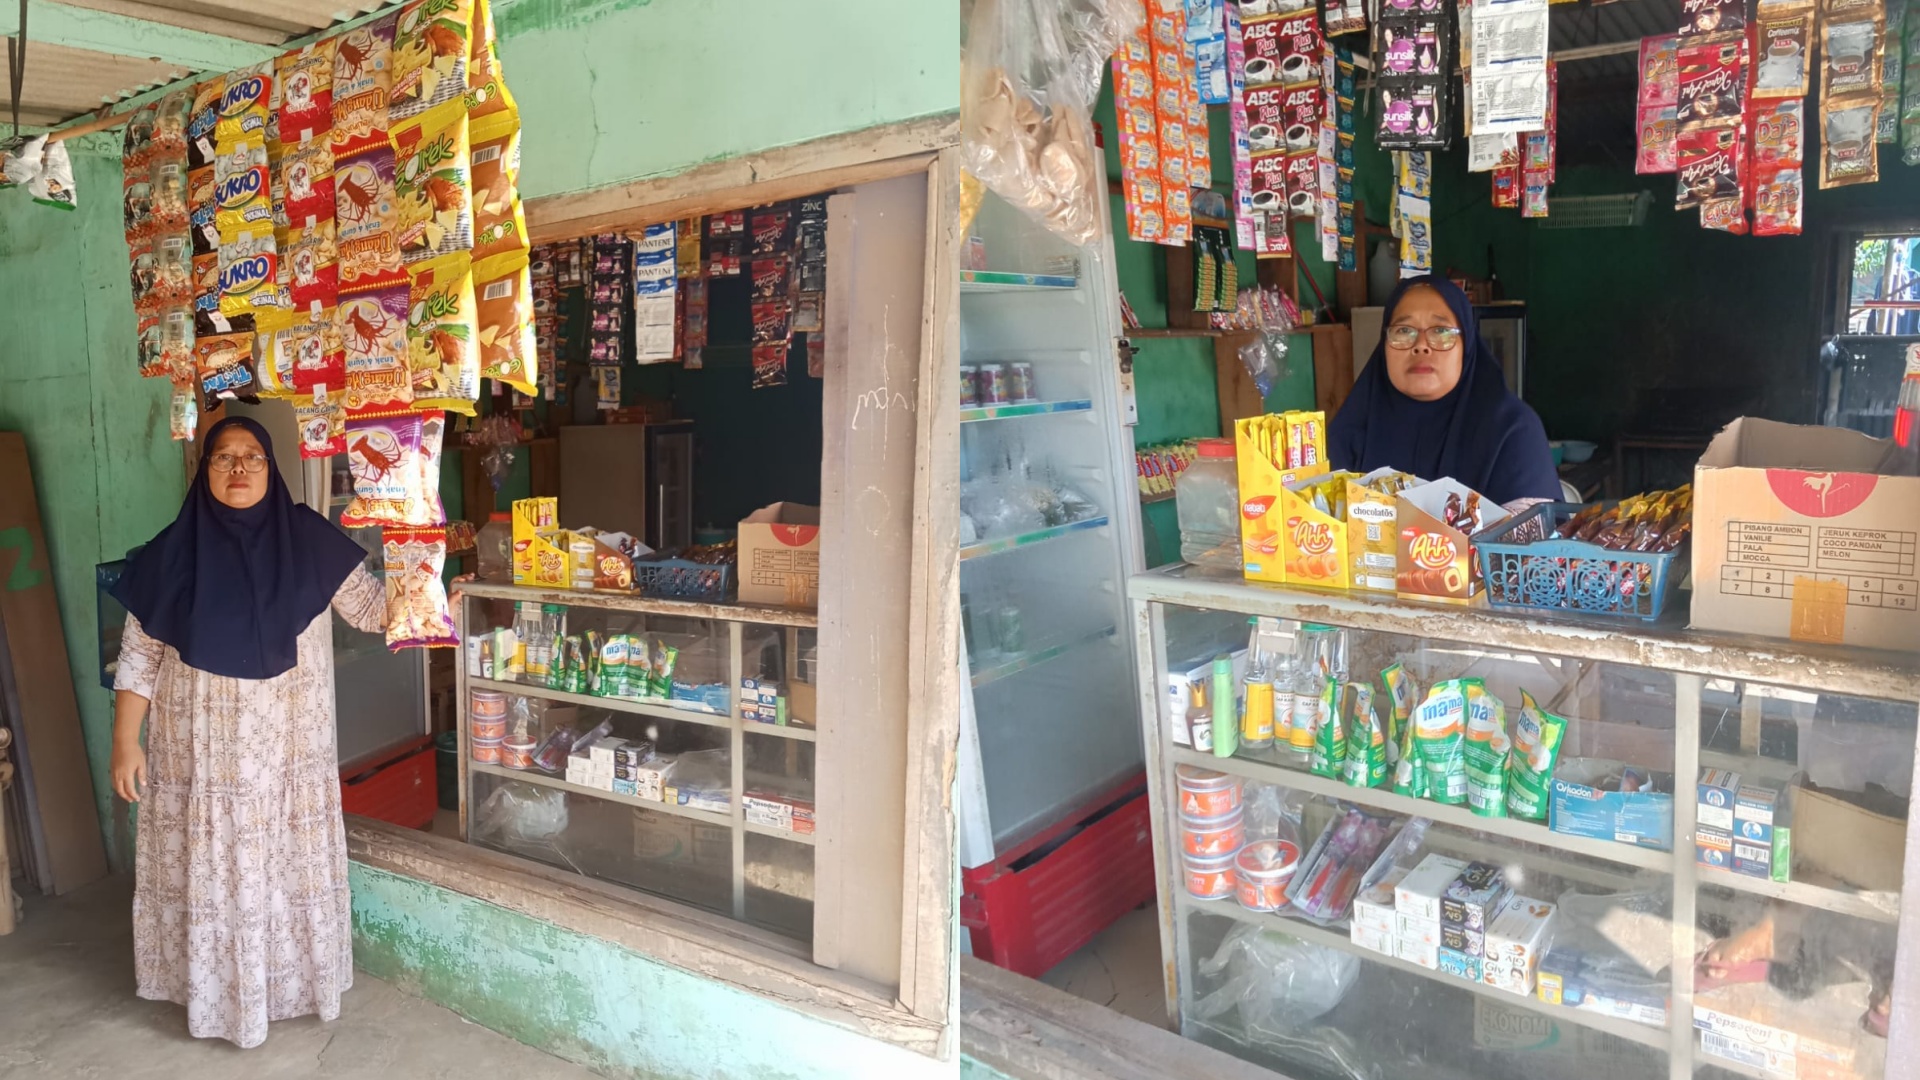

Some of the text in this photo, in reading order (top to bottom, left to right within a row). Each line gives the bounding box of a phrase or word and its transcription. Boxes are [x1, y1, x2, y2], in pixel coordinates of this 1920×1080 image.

[1244, 22, 1278, 40] ABC
[1281, 18, 1313, 36] ABC
[1256, 38, 1276, 55] Plus
[1293, 34, 1311, 51] Plus
[1385, 49, 1417, 61] sunsilk
[1246, 90, 1280, 107] ABC
[1286, 89, 1316, 107] ABC
[1259, 105, 1278, 121] Plus
[1296, 104, 1313, 121] Plus
[1383, 111, 1414, 122] sunsilk
[1253, 156, 1283, 173] ABC
[1288, 156, 1314, 174] ABC
[214, 170, 261, 206] SUKRO
[1265, 172, 1282, 188] Plus
[1298, 172, 1314, 188] Plus
[801, 201, 823, 212] ZINC
[638, 238, 672, 250] PANTENE
[1270, 243, 1288, 251] ABC
[217, 256, 269, 293] SUKRO
[375, 356, 394, 365] Enak
[364, 367, 407, 388] Udang
[1744, 524, 1773, 532] PISANG
[1823, 529, 1887, 540] JERUK KEPROK
[1744, 534, 1773, 542] VANILIE
[1823, 539, 1883, 550] COCO PANDAN
[1412, 533, 1453, 563] Ahh
[1743, 544, 1763, 552] PALA
[1822, 550, 1851, 558] MELON
[1743, 554, 1771, 562] MOCCA
[1860, 595, 1871, 603] 11
[1894, 598, 1906, 606] 12
[1485, 961, 1504, 973] Giv
[1505, 956, 1525, 967] Giv
[1707, 1012, 1773, 1038] Pepsodent
